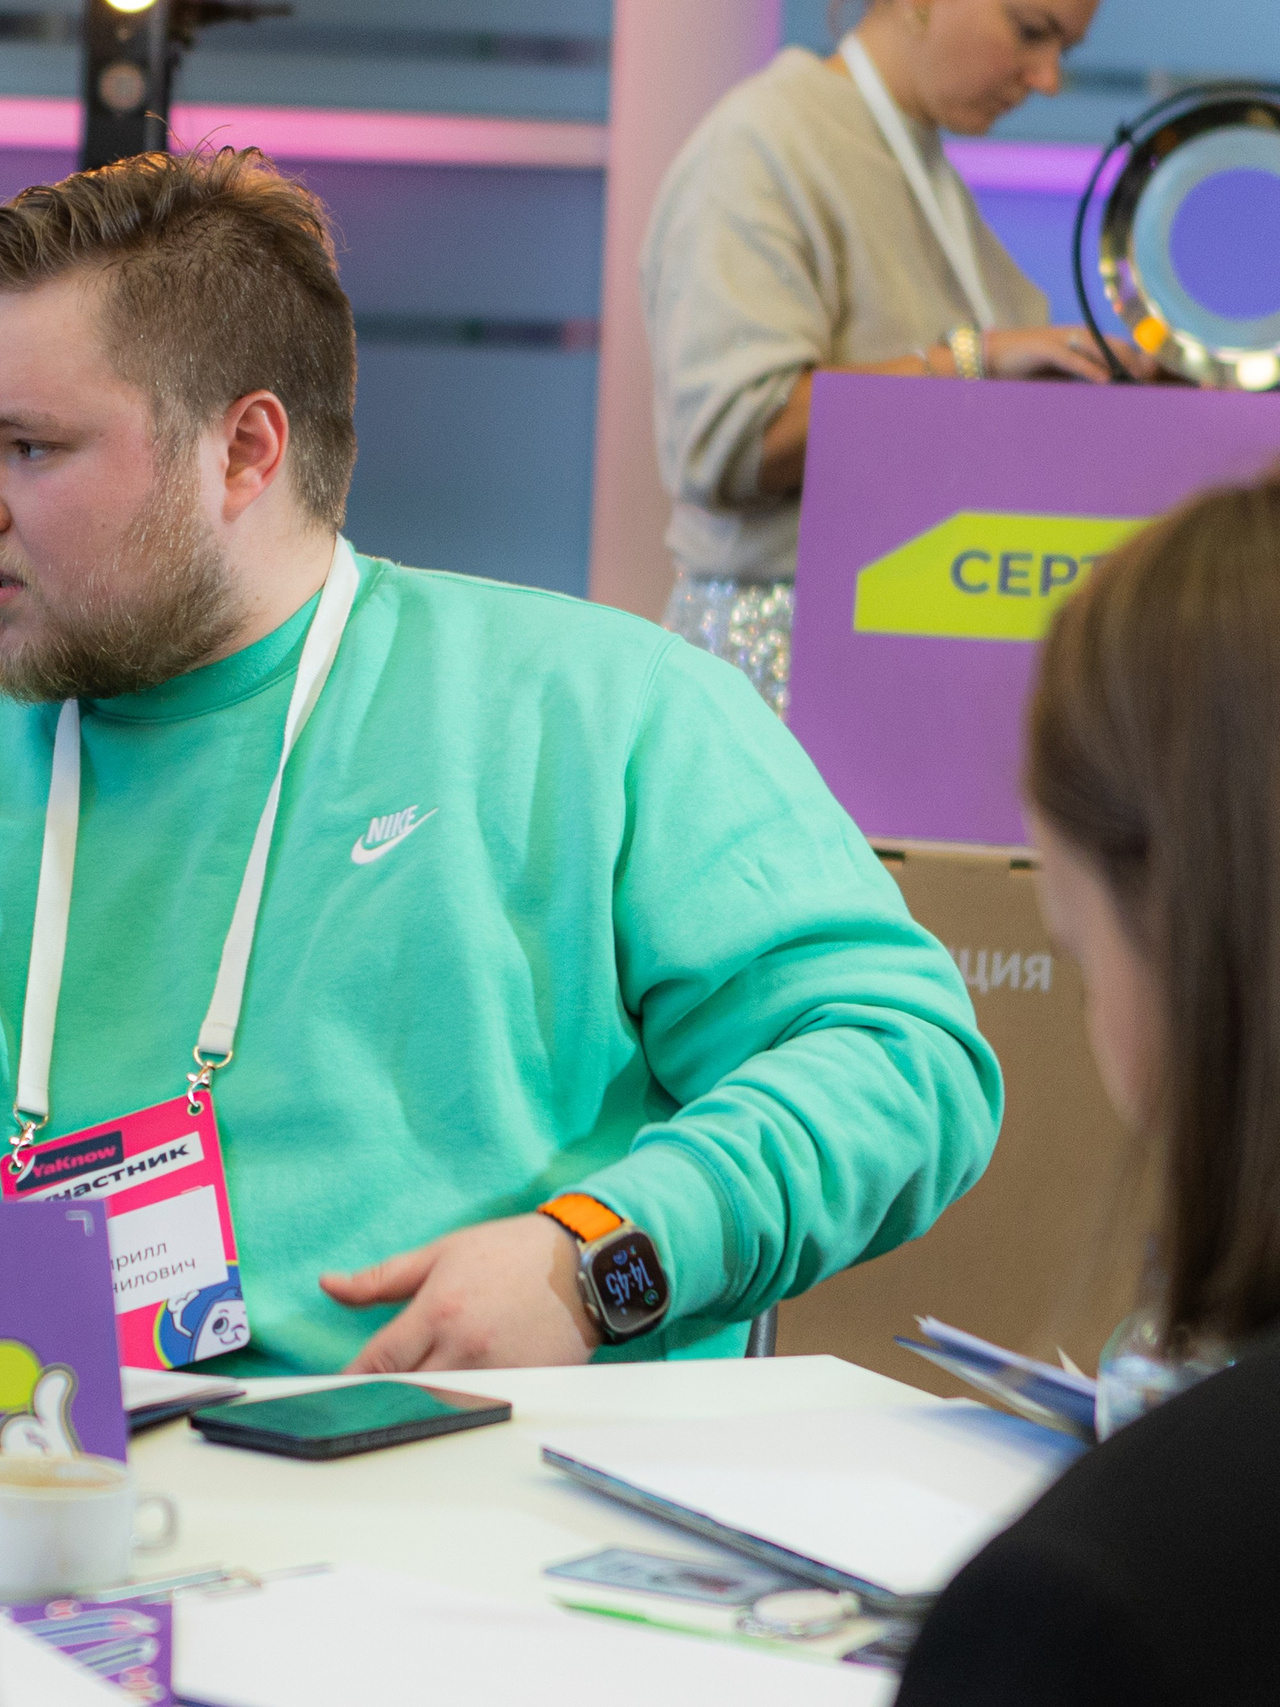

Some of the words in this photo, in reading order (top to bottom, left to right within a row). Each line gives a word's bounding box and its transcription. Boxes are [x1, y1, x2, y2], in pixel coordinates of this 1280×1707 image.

[366, 804, 419, 844] NIKE
[31, 1145, 117, 1179] YaKnow
[43, 1142, 190, 1201] частник
[605, 1257, 653, 1306] 14:45
